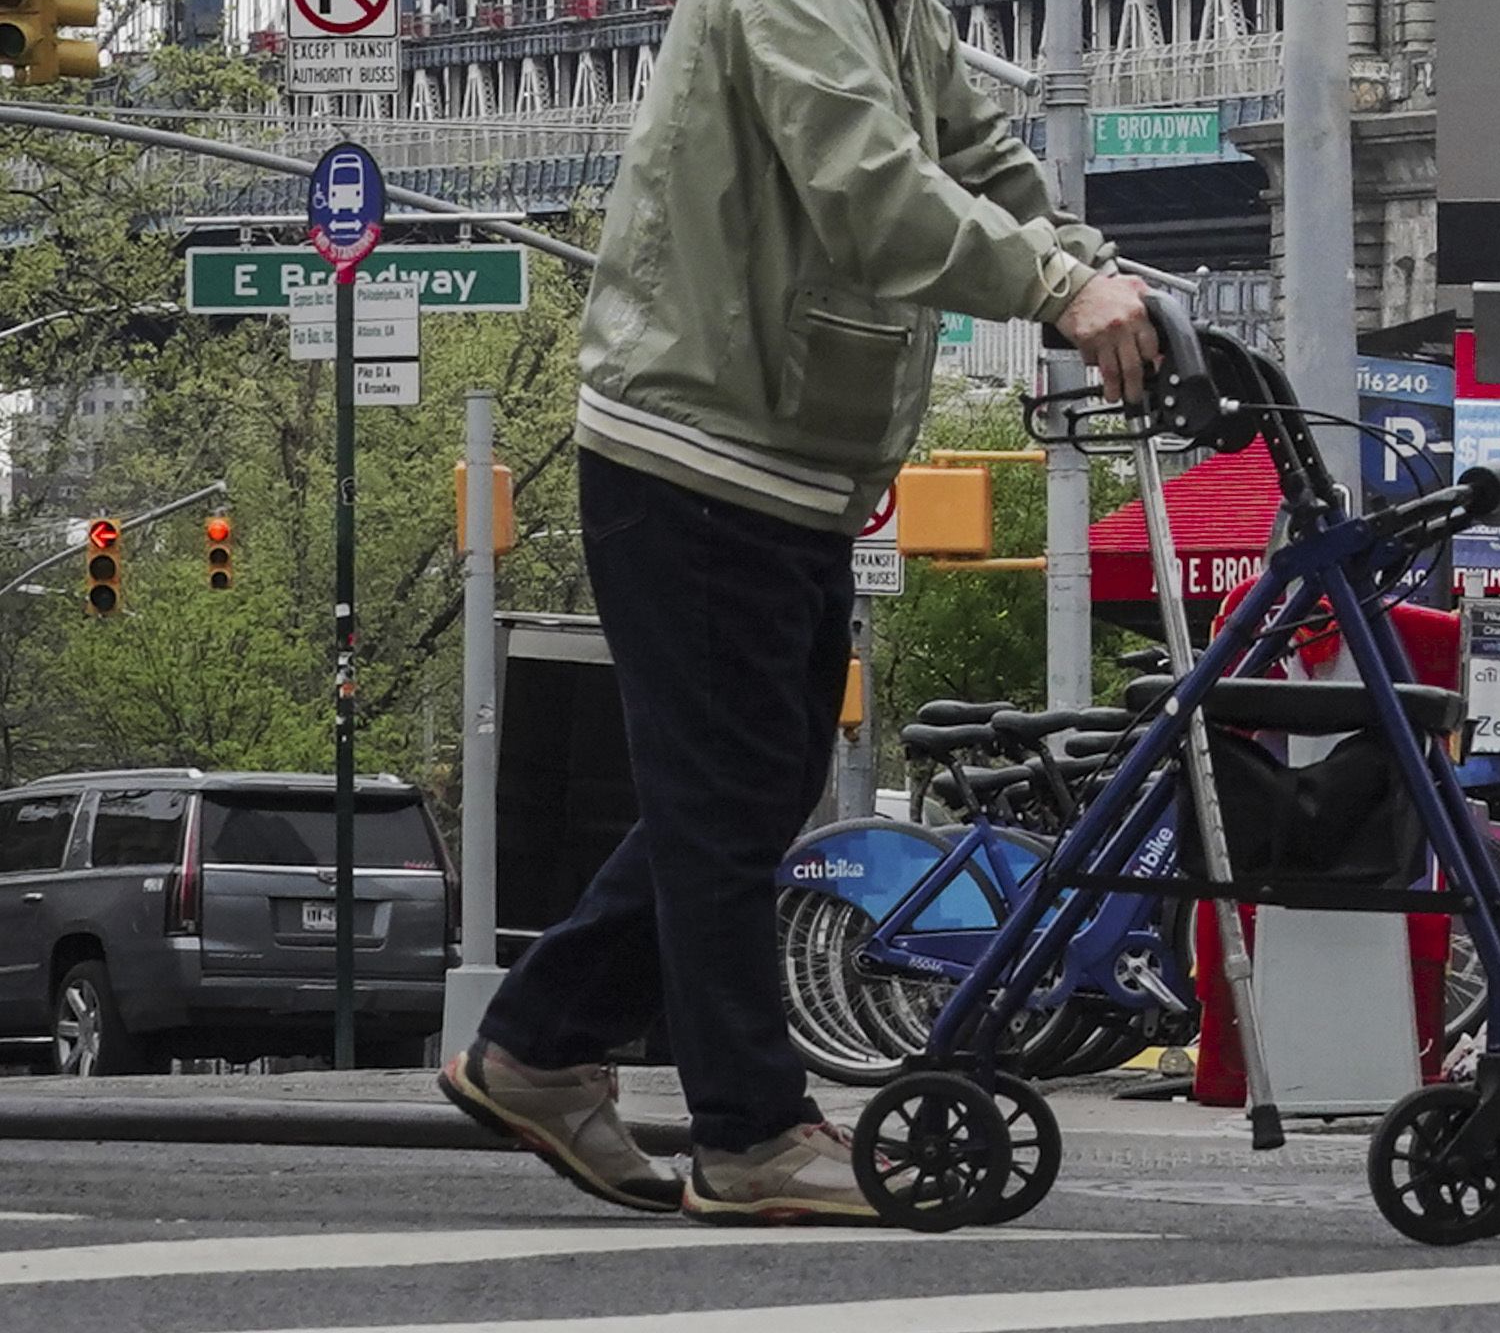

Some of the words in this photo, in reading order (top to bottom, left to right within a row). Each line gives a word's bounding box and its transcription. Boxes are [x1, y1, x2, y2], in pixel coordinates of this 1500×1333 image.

[292, 41, 337, 61] EXCEPT
[344, 41, 394, 59] TRANSIT
[291, 66, 353, 85] AUTHORITY
[359, 65, 395, 84] BUSES
[1097, 116, 1108, 141] E
[1117, 114, 1211, 140] BROADWAY
[234, 264, 258, 296] E
[1189, 557, 1208, 593] E.
[1474, 666, 1498, 683] citi
[792, 857, 824, 880] citi
[825, 859, 865, 879] bike
